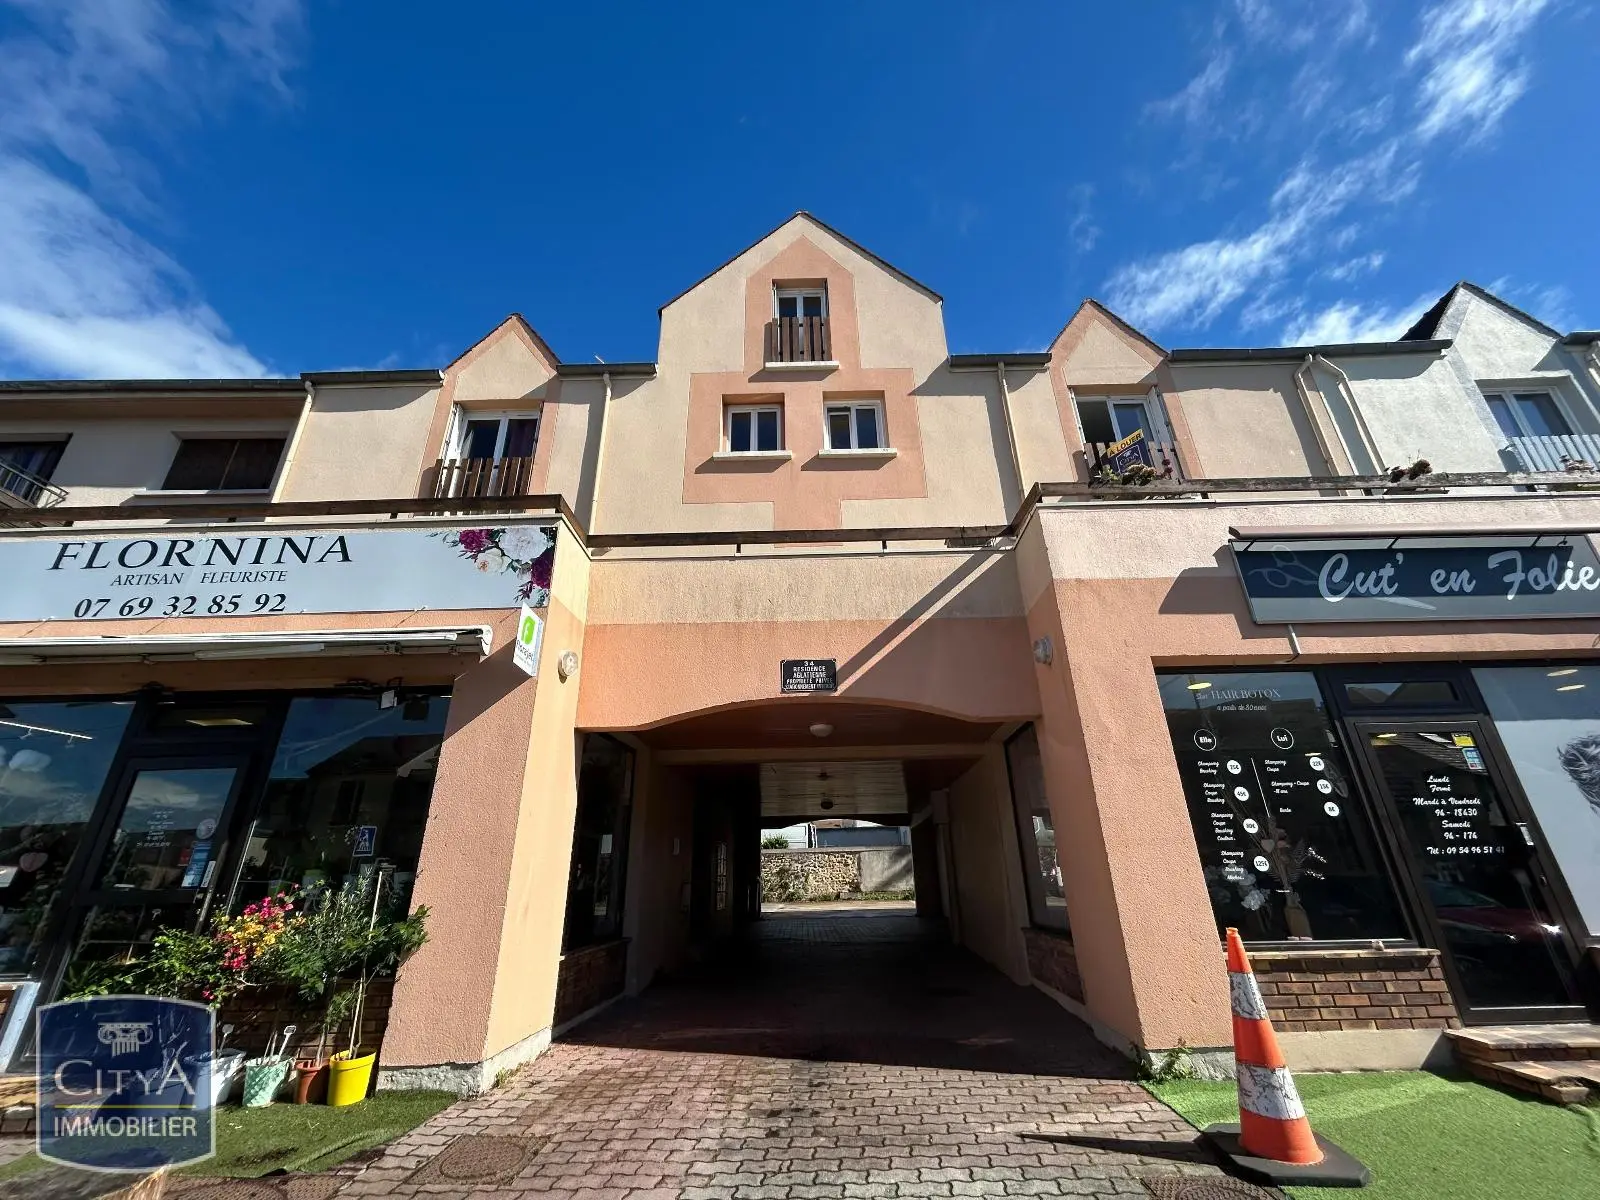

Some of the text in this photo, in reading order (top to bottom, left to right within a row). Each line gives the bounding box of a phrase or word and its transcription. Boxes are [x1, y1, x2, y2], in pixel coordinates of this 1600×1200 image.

[1116, 433, 1141, 452] LOUER
[110, 570, 288, 586] ARTISAN FLEURISTE
[1430, 568, 1476, 594] en
[1488, 550, 1600, 600] Folie
[74, 593, 286, 618] 07 69 32 85 92
[1211, 689, 1240, 700] HAIR
[1240, 688, 1281, 699] BOTOX
[1276, 734, 1288, 742] Lui
[1427, 775, 1450, 783] Lundi
[1429, 784, 1451, 793] Fermé
[1412, 797, 1439, 805] Mardi
[1448, 796, 1480, 805] Vendredi
[1441, 819, 1471, 828] Samedi
[1446, 846, 1457, 854] 09
[1471, 846, 1481, 854] 96
[1483, 846, 1493, 854] 51
